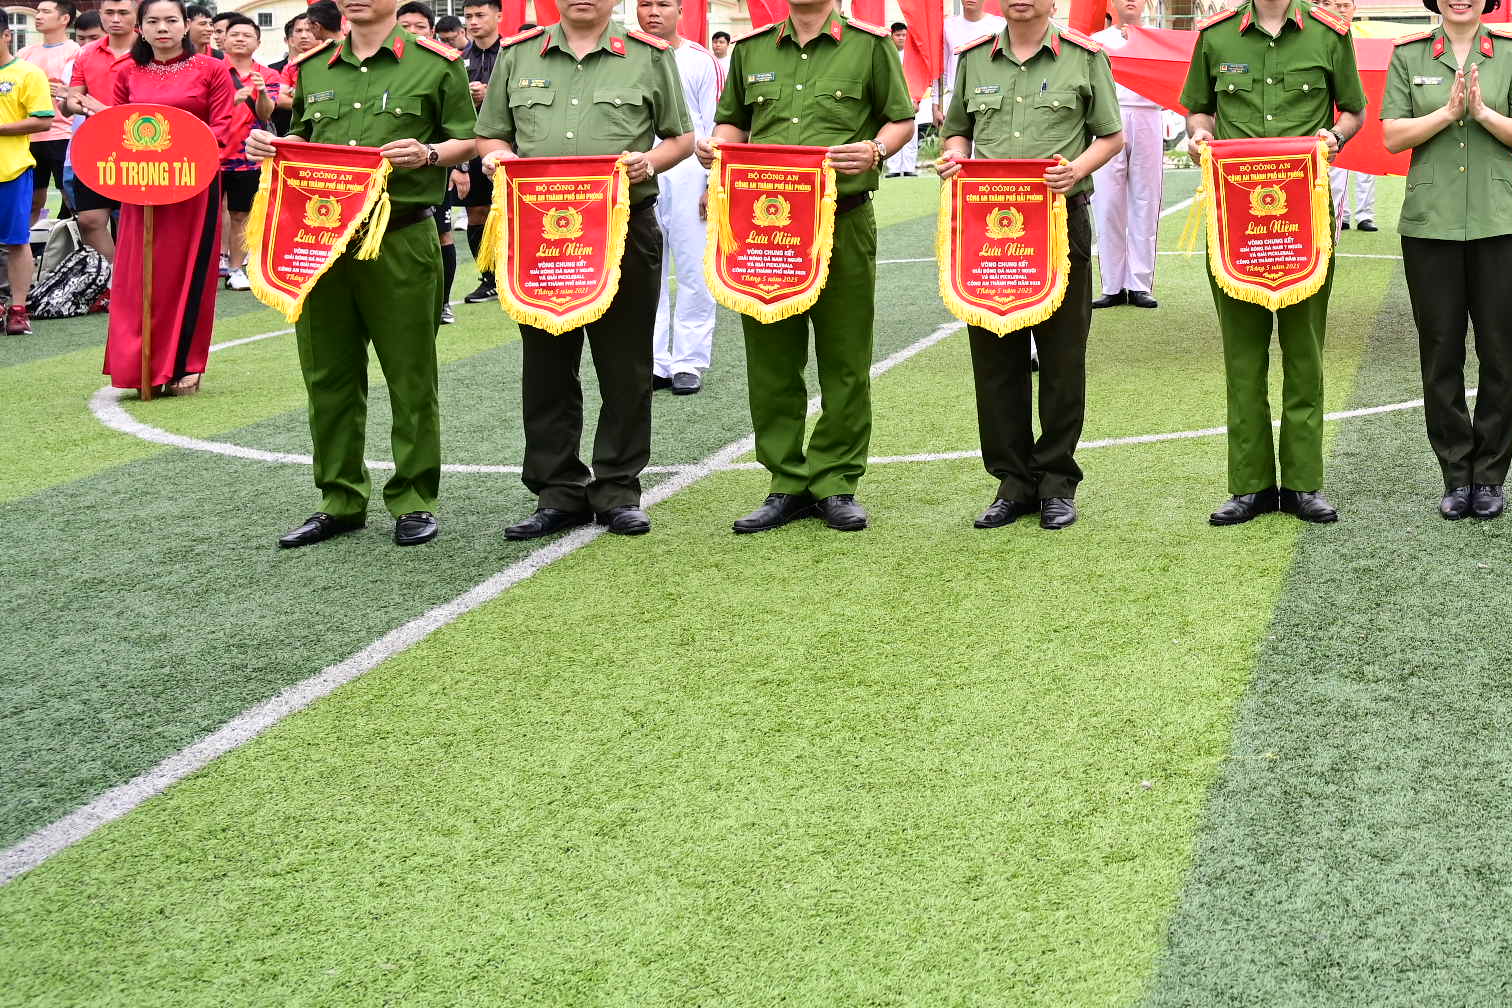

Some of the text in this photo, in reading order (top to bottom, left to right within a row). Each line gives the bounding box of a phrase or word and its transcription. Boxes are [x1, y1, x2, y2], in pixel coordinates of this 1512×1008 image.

[97, 152, 196, 191] TỔ TRỌNG TÀI
[748, 172, 759, 180] BỘ
[761, 172, 784, 180] CÔNG
[979, 185, 990, 193] BỘ
[1270, 220, 1299, 236] Niệm
[318, 231, 338, 245] Ni
[771, 231, 800, 248] Niệm
[563, 242, 592, 259] Niệm
[1005, 243, 1034, 260] Niệm
